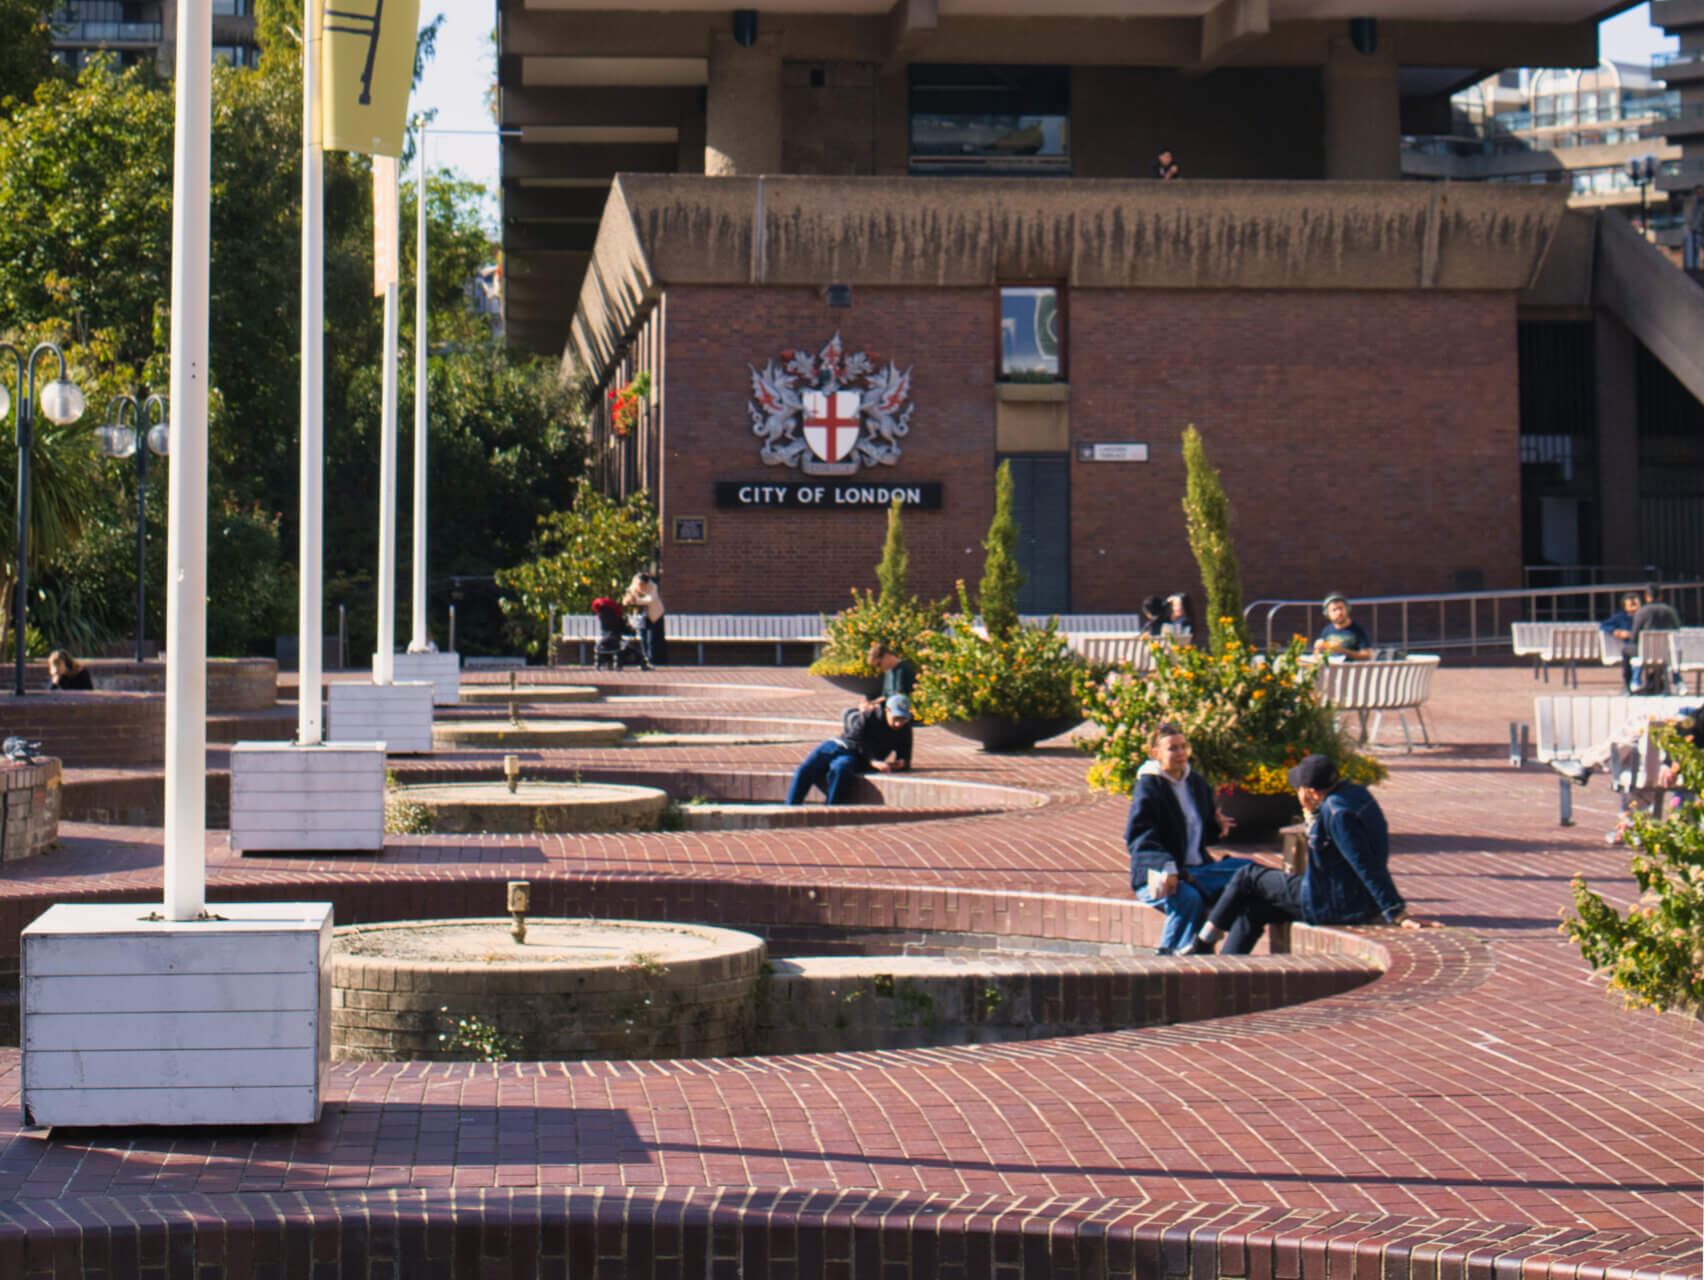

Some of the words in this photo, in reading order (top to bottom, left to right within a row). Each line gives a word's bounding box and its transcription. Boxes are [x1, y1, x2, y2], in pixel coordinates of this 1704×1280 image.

[738, 486, 787, 504] CITY
[797, 487, 825, 504] OF
[834, 487, 921, 504] LONDON
